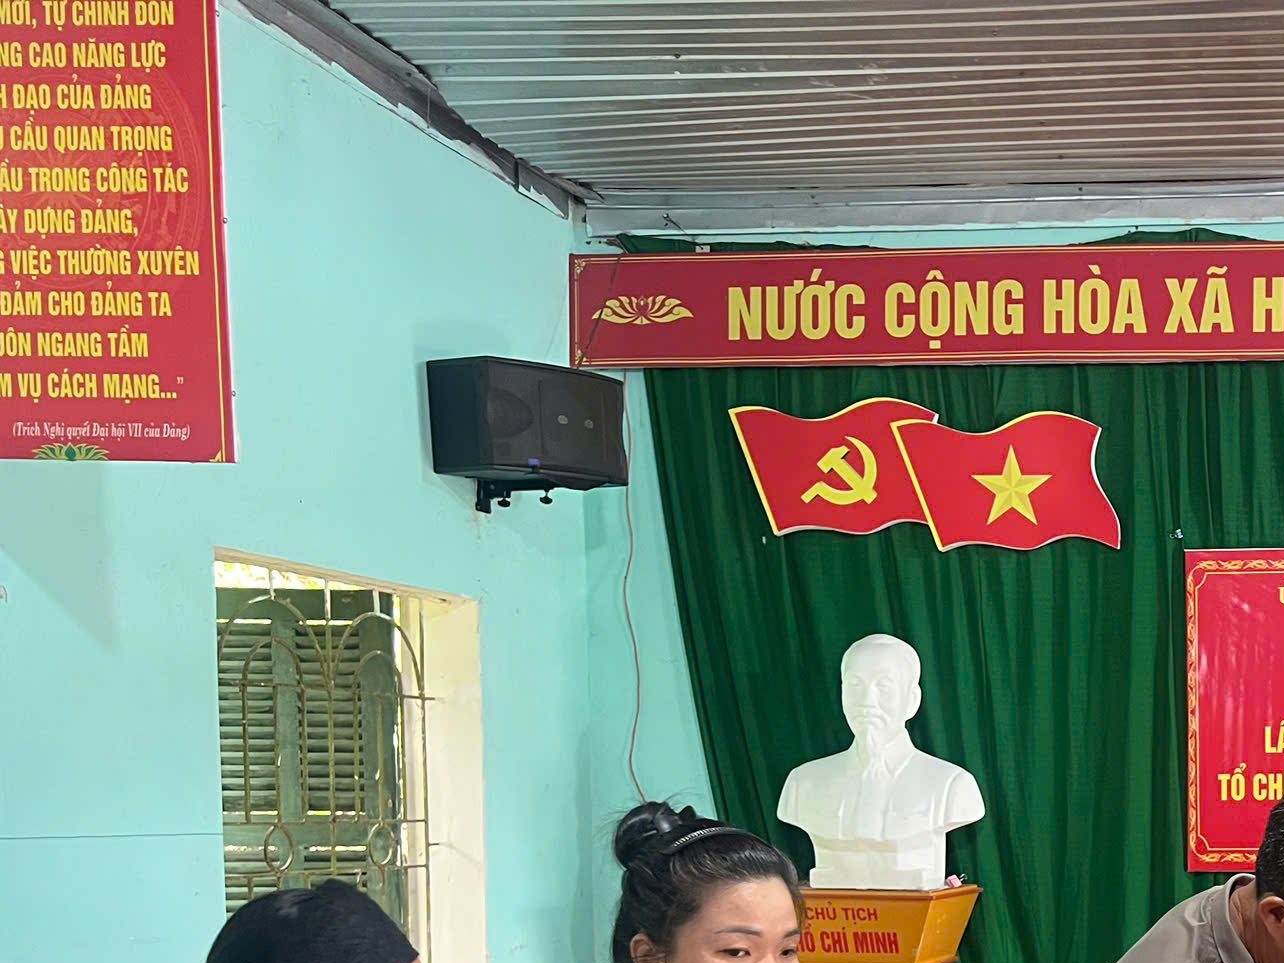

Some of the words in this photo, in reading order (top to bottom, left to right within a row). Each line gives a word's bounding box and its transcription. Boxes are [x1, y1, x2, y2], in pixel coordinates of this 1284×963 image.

[29, 42, 67, 68] CAO
[73, 38, 125, 68] NĂNG
[131, 40, 166, 72] LỰC
[12, 84, 51, 115] ĐẠO
[56, 73, 95, 110] CỦA
[100, 73, 152, 110] ĐẢNG
[10, 117, 48, 151] CẦU
[53, 126, 105, 153] QUAN
[110, 126, 173, 157] TRỌNG
[28, 167, 91, 192] TRONG
[96, 162, 148, 192] CÔNG
[153, 162, 189, 192] TÁC
[24, 206, 76, 239] DỰNG
[81, 198, 138, 236] ĐẢNG,
[10, 245, 52, 280] VIỆC
[57, 243, 132, 276] THƯỜNG
[137, 245, 200, 276] XUYÊN
[0, 280, 42, 316] ĐẢM
[48, 291, 86, 316] CHO
[91, 280, 143, 316] ĐẢNG
[148, 292, 172, 316] TA
[728, 269, 866, 340] NƯỚC
[885, 270, 1024, 349] CỘNG
[1043, 265, 1147, 335] HÒA
[1164, 265, 1235, 334] XÃ
[37, 332, 102, 357] NGANG
[108, 324, 148, 357] TẦM
[17, 373, 42, 403] VỤ
[47, 368, 98, 398] CÁCH
[43, 422, 64, 441] Nghị
[66, 420, 90, 441] quyết
[92, 422, 109, 441] Đại
[111, 422, 126, 441] hội
[128, 422, 143, 438] VII
[143, 422, 160, 438] của
[1218, 762, 1247, 801] TỔ
[806, 901, 837, 920] CHỦ
[841, 907, 879, 925] TỊCH
[820, 926, 849, 953] CHÍ
[853, 931, 899, 954] MINH
